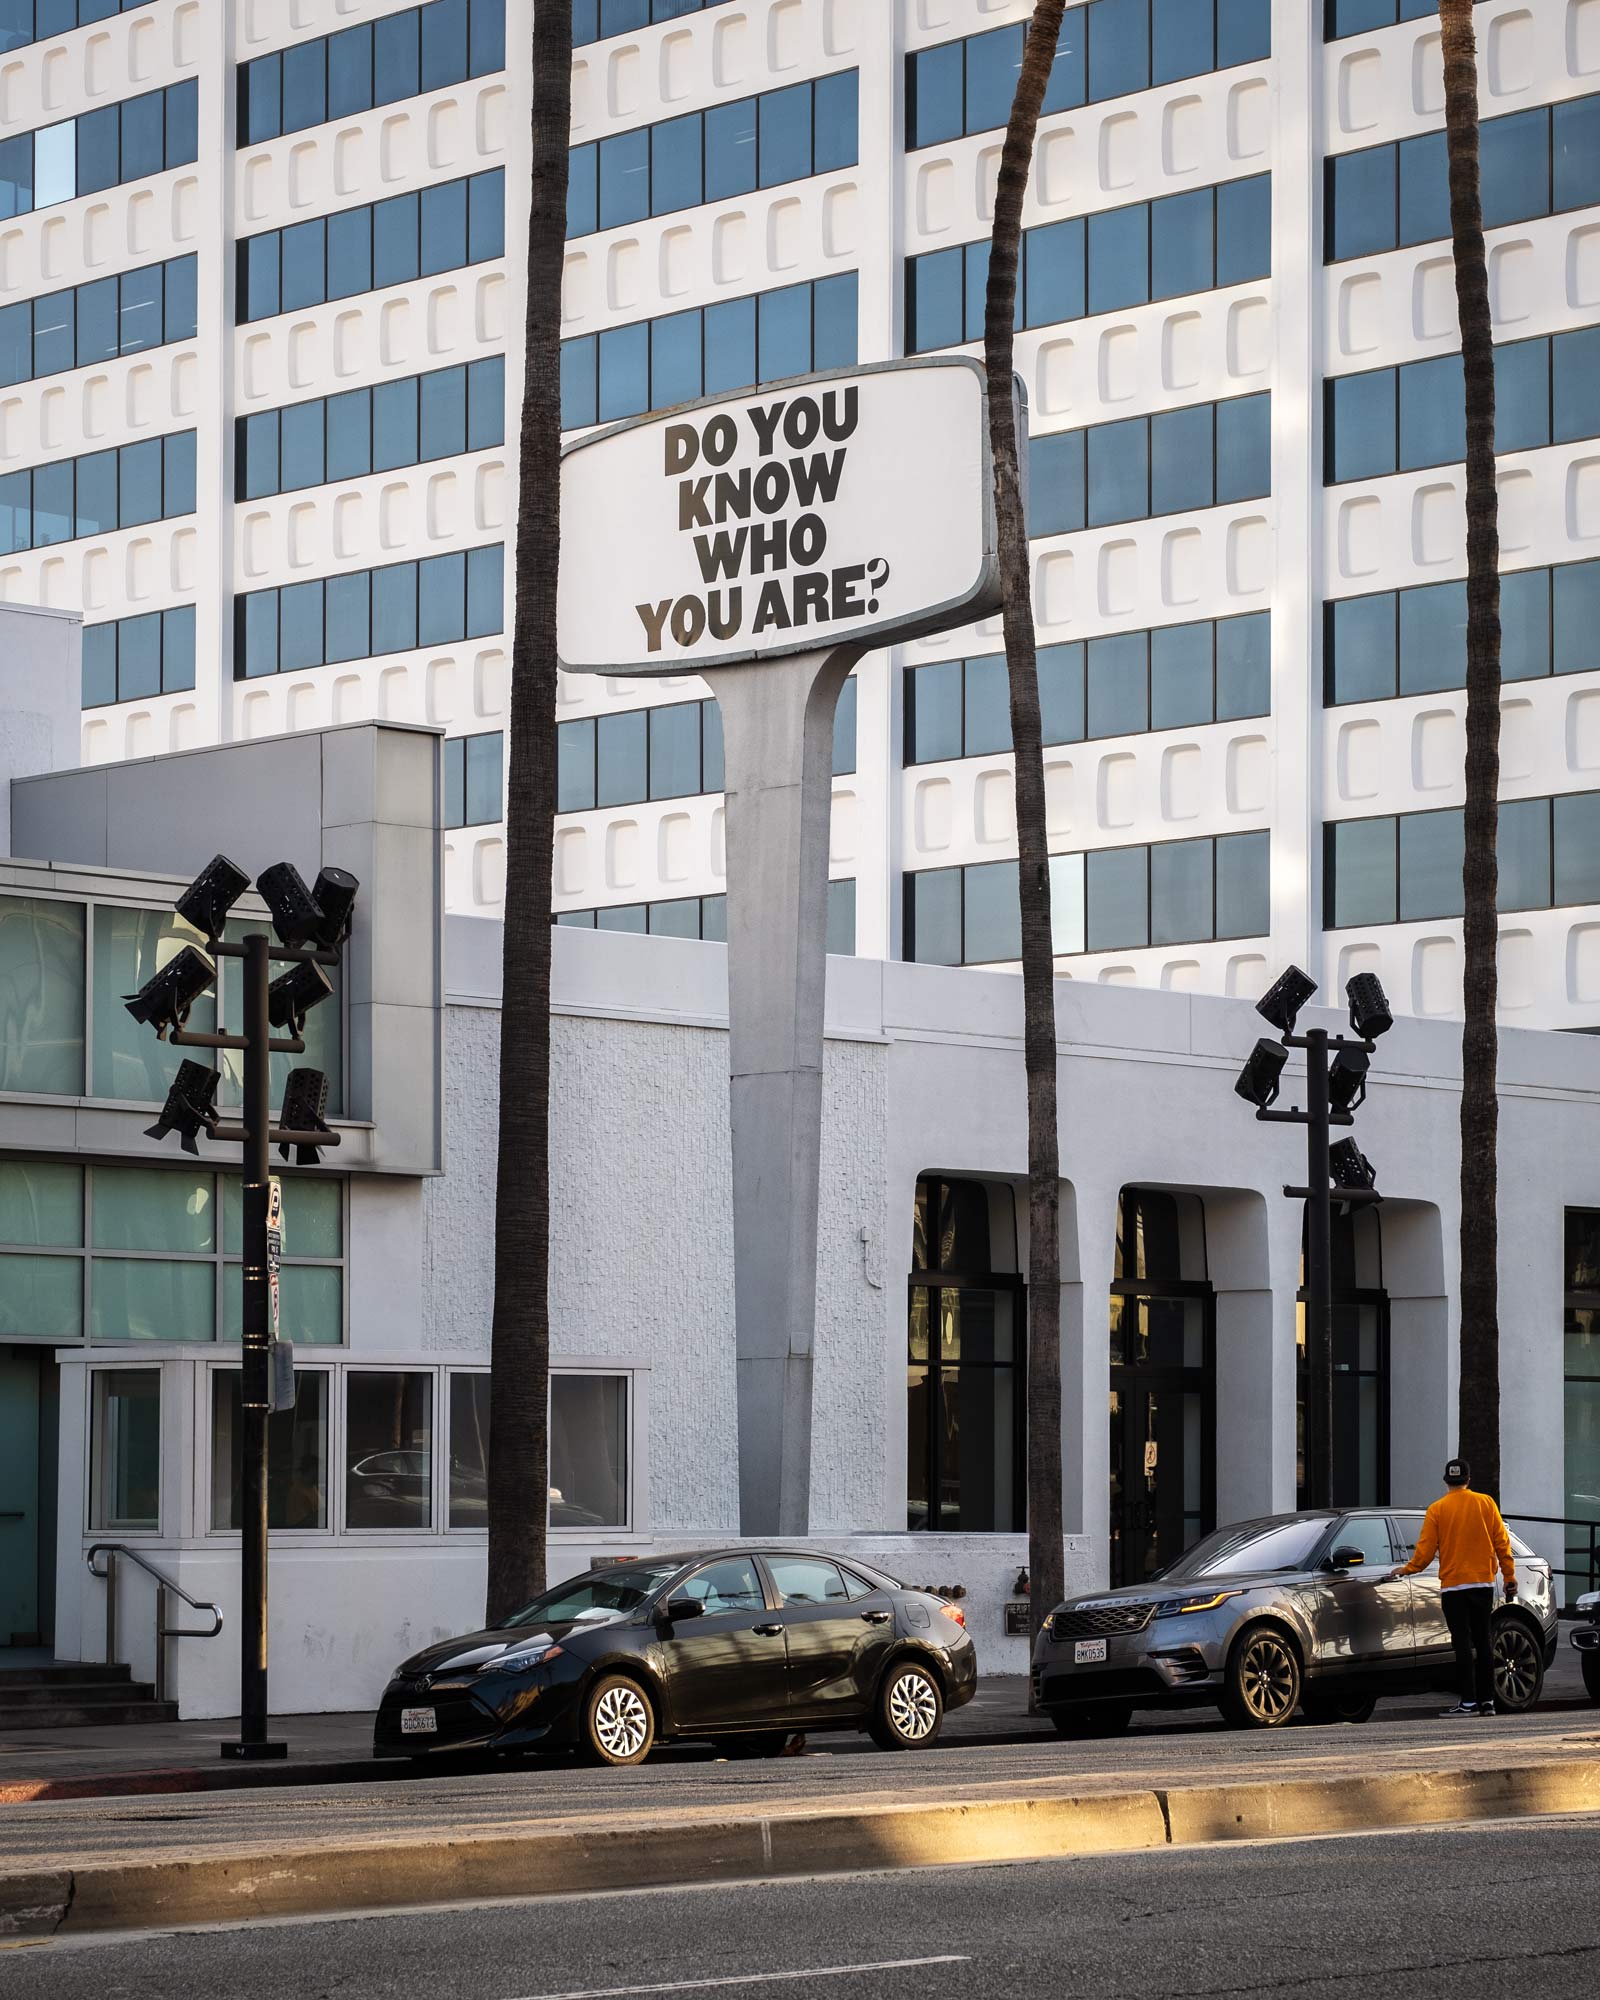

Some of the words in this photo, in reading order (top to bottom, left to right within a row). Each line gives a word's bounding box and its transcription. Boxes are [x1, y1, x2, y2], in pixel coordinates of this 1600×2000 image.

[665, 413, 738, 477] DO
[747, 385, 859, 457] YOU
[679, 447, 847, 531] KNOW
[693, 513, 827, 584] WHO
[635, 586, 742, 653] YOU
[752, 557, 890, 634] ARE?
